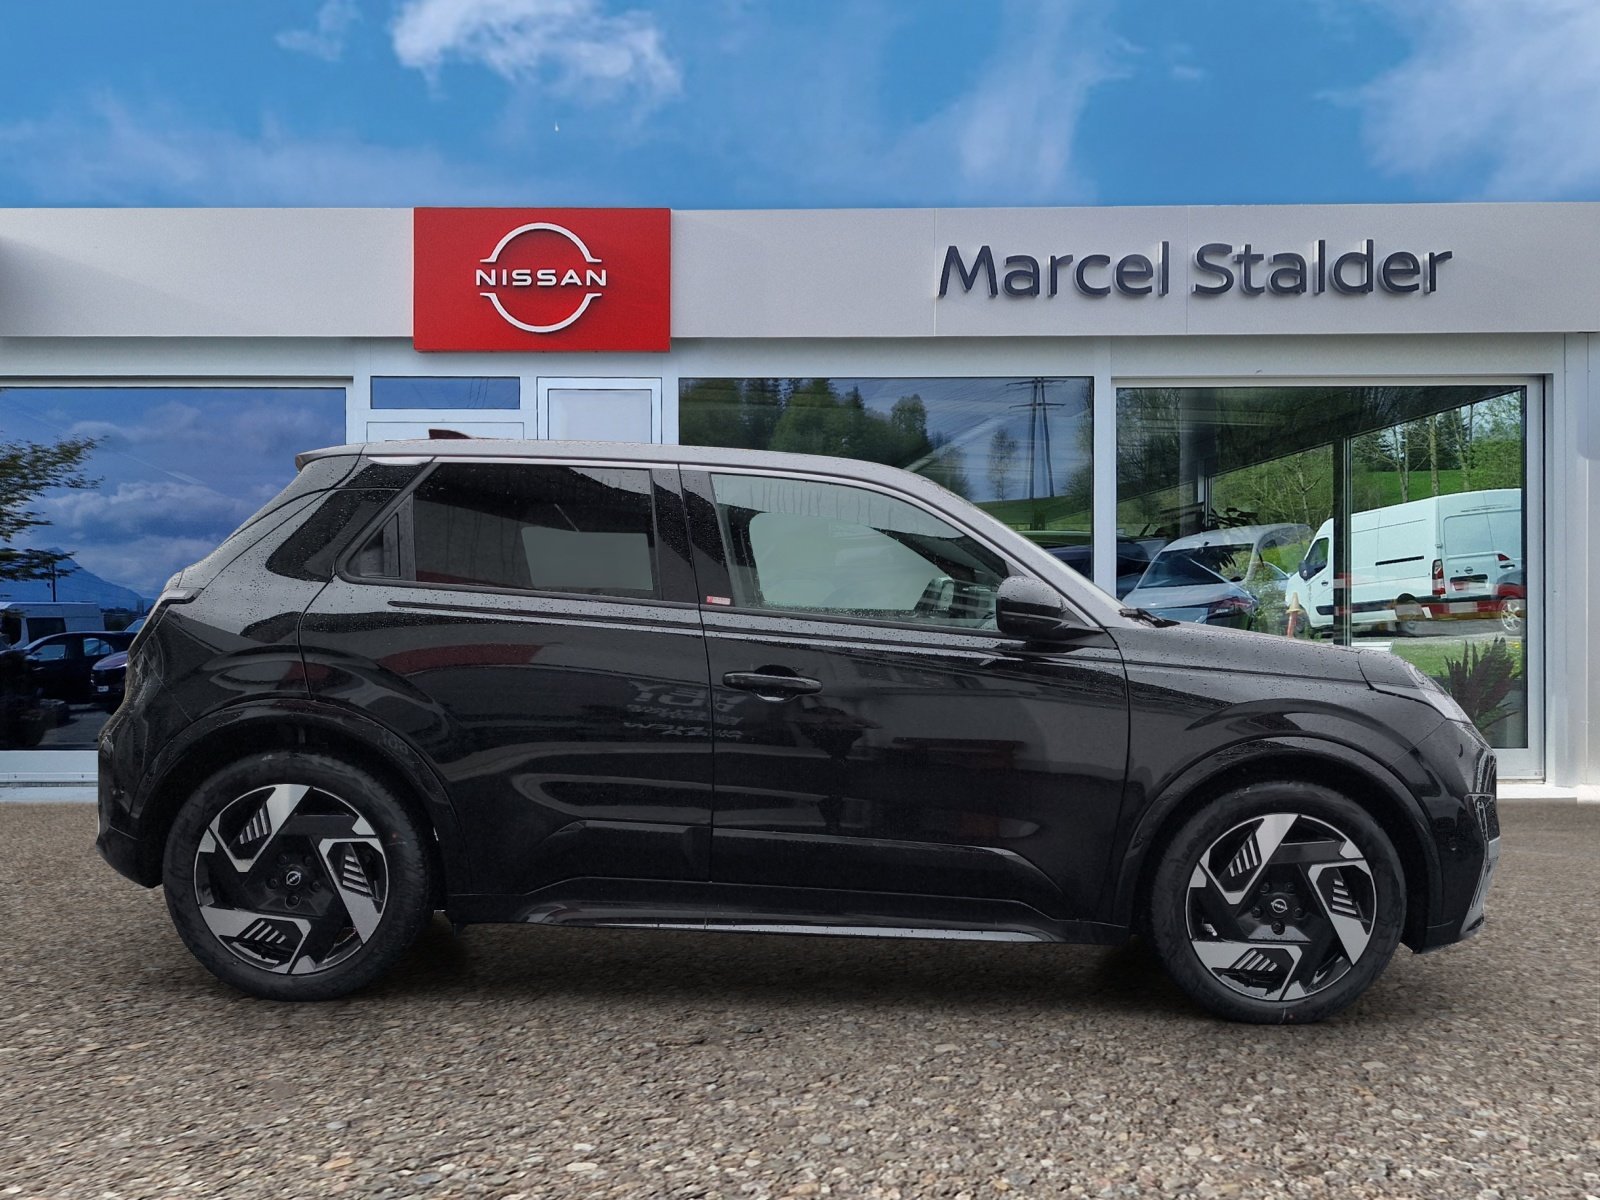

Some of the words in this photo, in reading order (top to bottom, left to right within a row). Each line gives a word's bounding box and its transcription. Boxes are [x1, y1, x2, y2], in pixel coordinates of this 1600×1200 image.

[475, 269, 607, 287] NISSAN
[938, 241, 1170, 298] Marcel
[1192, 239, 1453, 297] Stalder
